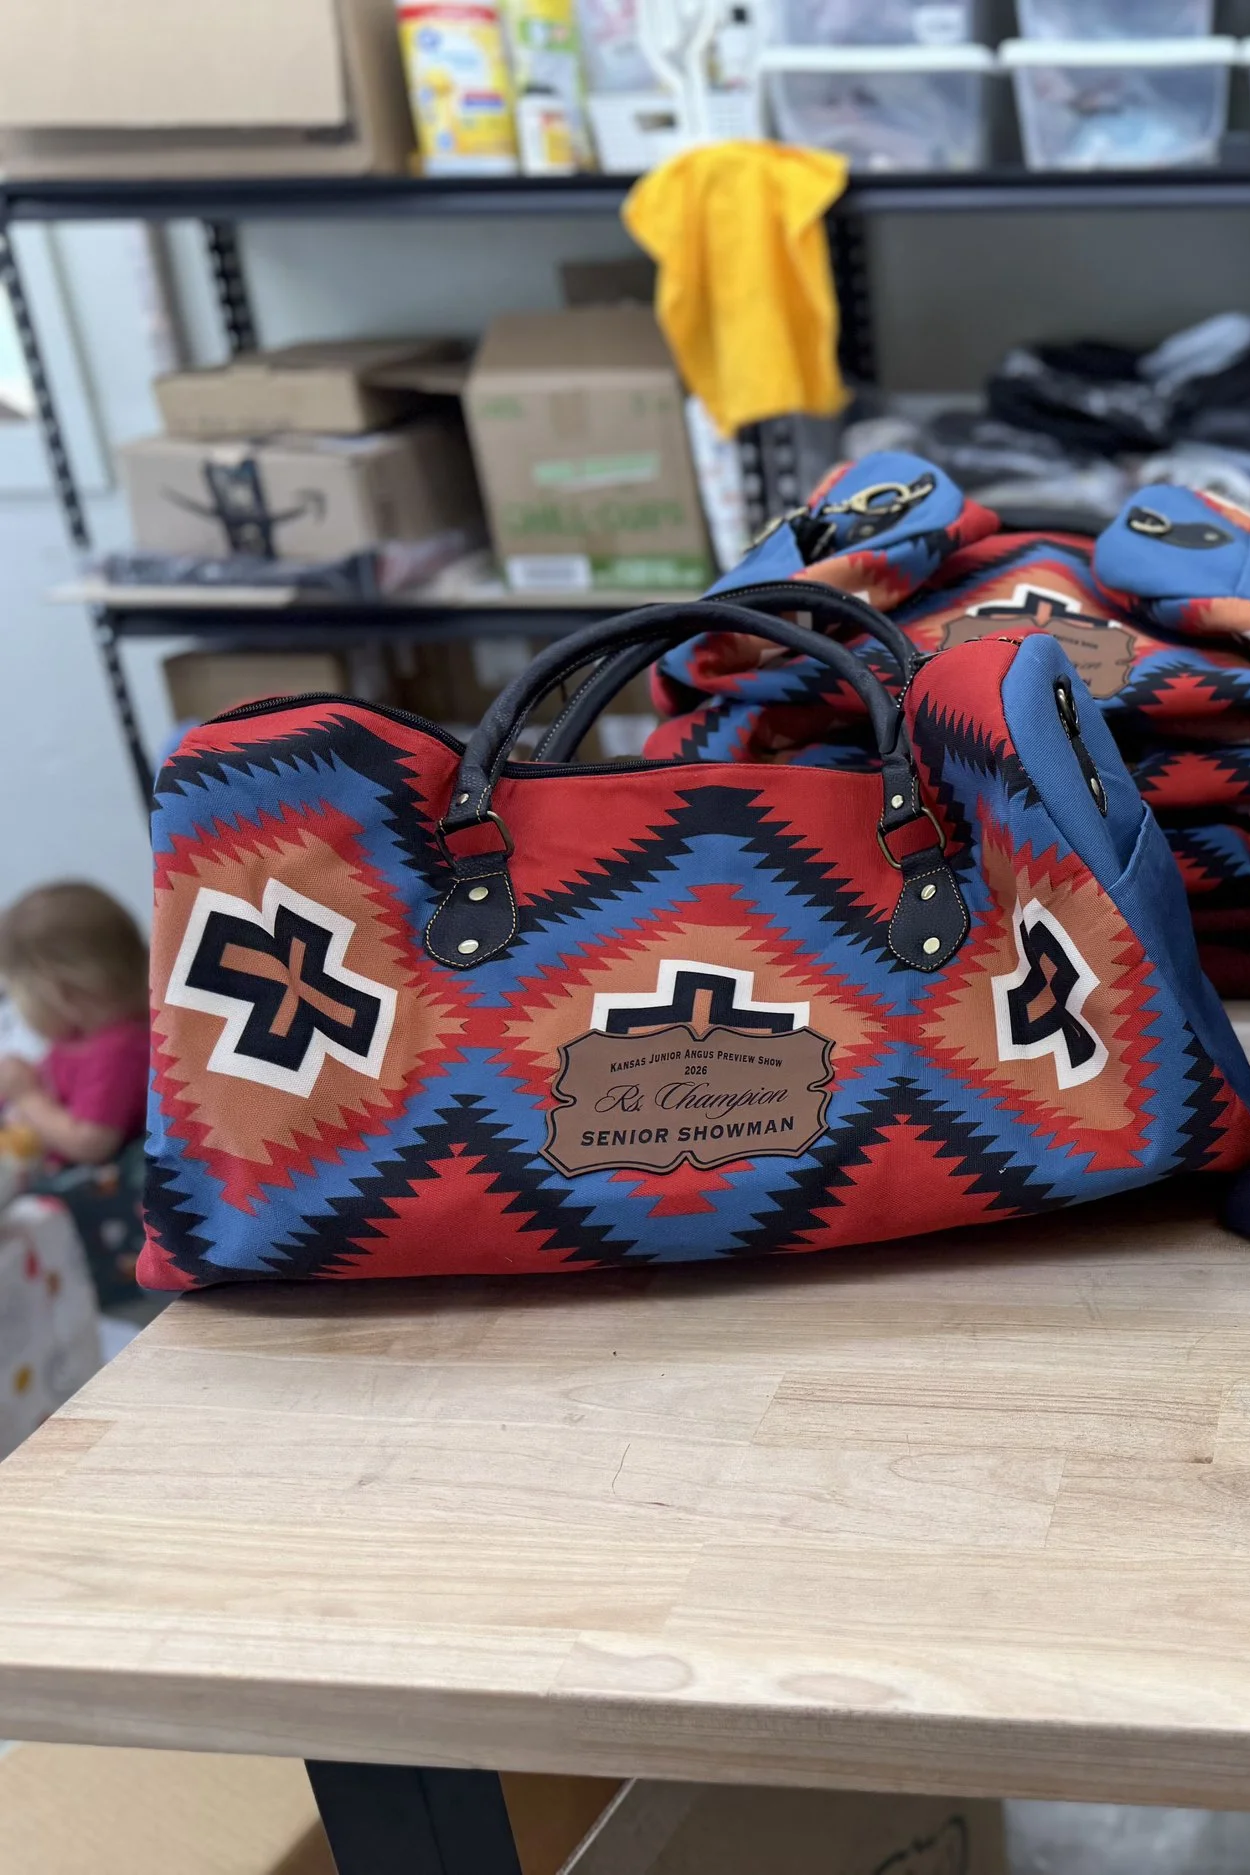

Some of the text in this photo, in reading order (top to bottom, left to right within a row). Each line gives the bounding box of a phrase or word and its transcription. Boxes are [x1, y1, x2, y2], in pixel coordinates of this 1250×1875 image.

[609, 1049, 783, 1073] KANSAS JUNIOR ANGUS PREVIEW SHOW
[684, 1065, 708, 1076] 2026
[654, 1081, 789, 1120] Champion
[580, 1115, 795, 1147] SENIOR SHOWMAN
